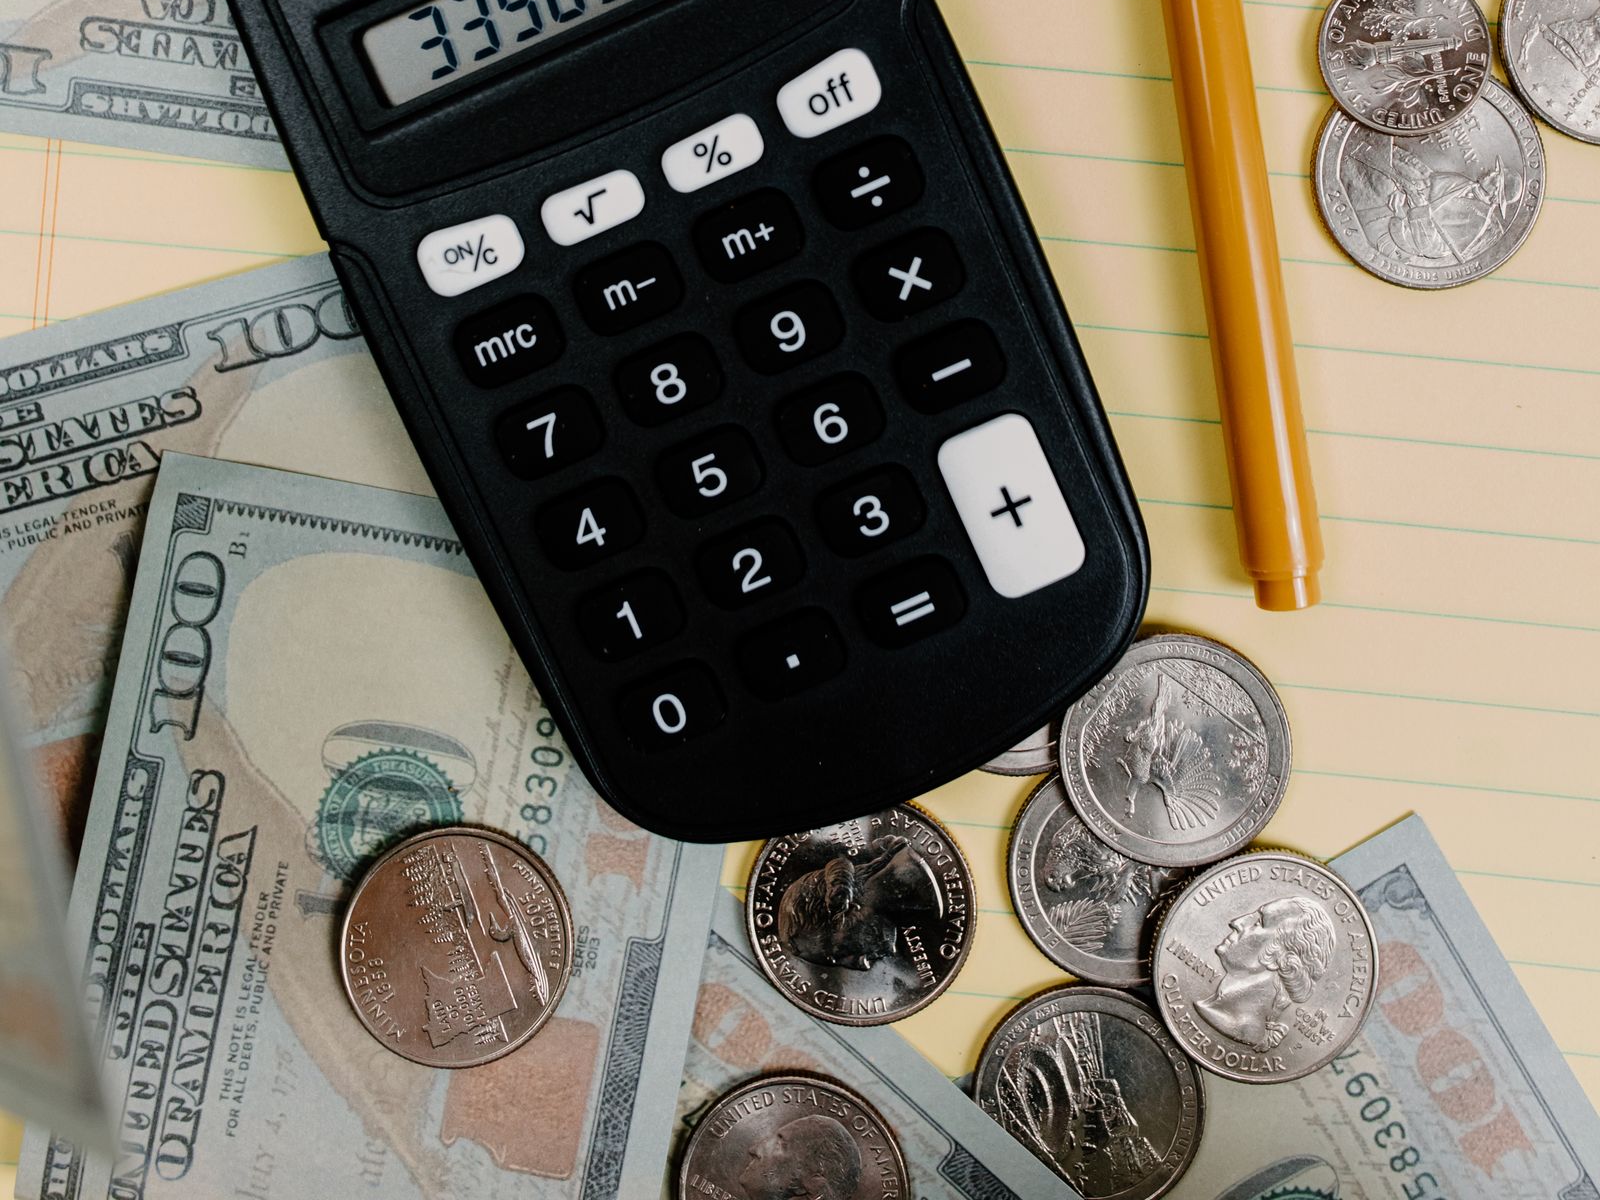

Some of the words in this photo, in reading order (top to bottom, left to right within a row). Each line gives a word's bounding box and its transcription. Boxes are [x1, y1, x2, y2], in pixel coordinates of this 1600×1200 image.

[1328, 18, 1347, 43] OF
[807, 72, 854, 117] off
[1328, 50, 1371, 113] STATES
[1453, 52, 1488, 103] ONE
[1372, 106, 1446, 130] UNITED
[473, 321, 537, 368] mrc
[769, 310, 807, 353] 9
[0, 328, 174, 396] OLLARS
[648, 361, 687, 405] 8
[525, 412, 558, 459] 7
[812, 401, 849, 444] 6
[691, 453, 729, 498] 5
[8, 527, 59, 551] PUBLIC
[63, 518, 93, 539] AND
[14, 515, 59, 537] LEGAL
[62, 498, 117, 522] TENDER
[575, 506, 607, 547] 4
[851, 494, 891, 538] 3
[731, 546, 773, 593] 2
[615, 599, 643, 640] 1
[149, 550, 226, 741] 100
[1155, 643, 1229, 667] LOUISIANA
[652, 692, 688, 735] 0
[1221, 773, 1281, 848] KISATCHIE
[86, 766, 149, 974] DOLLARS
[148, 768, 226, 999] STATES
[511, 858, 545, 900] UNUM
[758, 828, 814, 895] AMERIC
[1270, 865, 1336, 901] STATES
[269, 860, 290, 921] PRIVATE
[1193, 865, 1263, 908] UNITED
[249, 890, 269, 949] TENDER
[518, 891, 550, 941] 2005
[541, 896, 562, 958] PLURIBUS
[755, 901, 774, 929] OF
[939, 866, 966, 961] QUARTER
[1334, 901, 1358, 924] OF
[262, 922, 278, 956] AND
[584, 936, 600, 970] 2013
[901, 925, 938, 989] LIBERTY
[1166, 938, 1223, 984] LIBERTY
[170, 825, 258, 1106] AMERICA
[238, 951, 259, 1001] LEGAL
[349, 920, 406, 1043] MINNESOTA
[367, 956, 394, 1004] 1858
[759, 933, 812, 995] STATES
[1338, 932, 1368, 1019] AMERICA
[250, 959, 270, 1016] PUBLIC
[465, 983, 488, 1021] LAKES
[813, 989, 888, 1016] UNITED
[237, 1004, 247, 1021] IS
[432, 998, 452, 1033] LAND
[443, 1003, 459, 1020] OF
[1162, 972, 1211, 1055] QUARTER
[1211, 1045, 1287, 1073] DOLLAR
[1293, 1020, 1326, 1047] TRUST
[1315, 1007, 1329, 1022] IN
[227, 1022, 242, 1067] NOTE
[219, 1070, 236, 1104] THIS
[232, 1074, 249, 1104] ALL
[1135, 1014, 1188, 1074] CHACO
[1166, 1084, 1195, 1172] CULTURE
[225, 1108, 241, 1139] FOR
[708, 1090, 776, 1139] UNITED
[782, 1085, 851, 1118] STATES
[852, 1114, 879, 1141] OF
